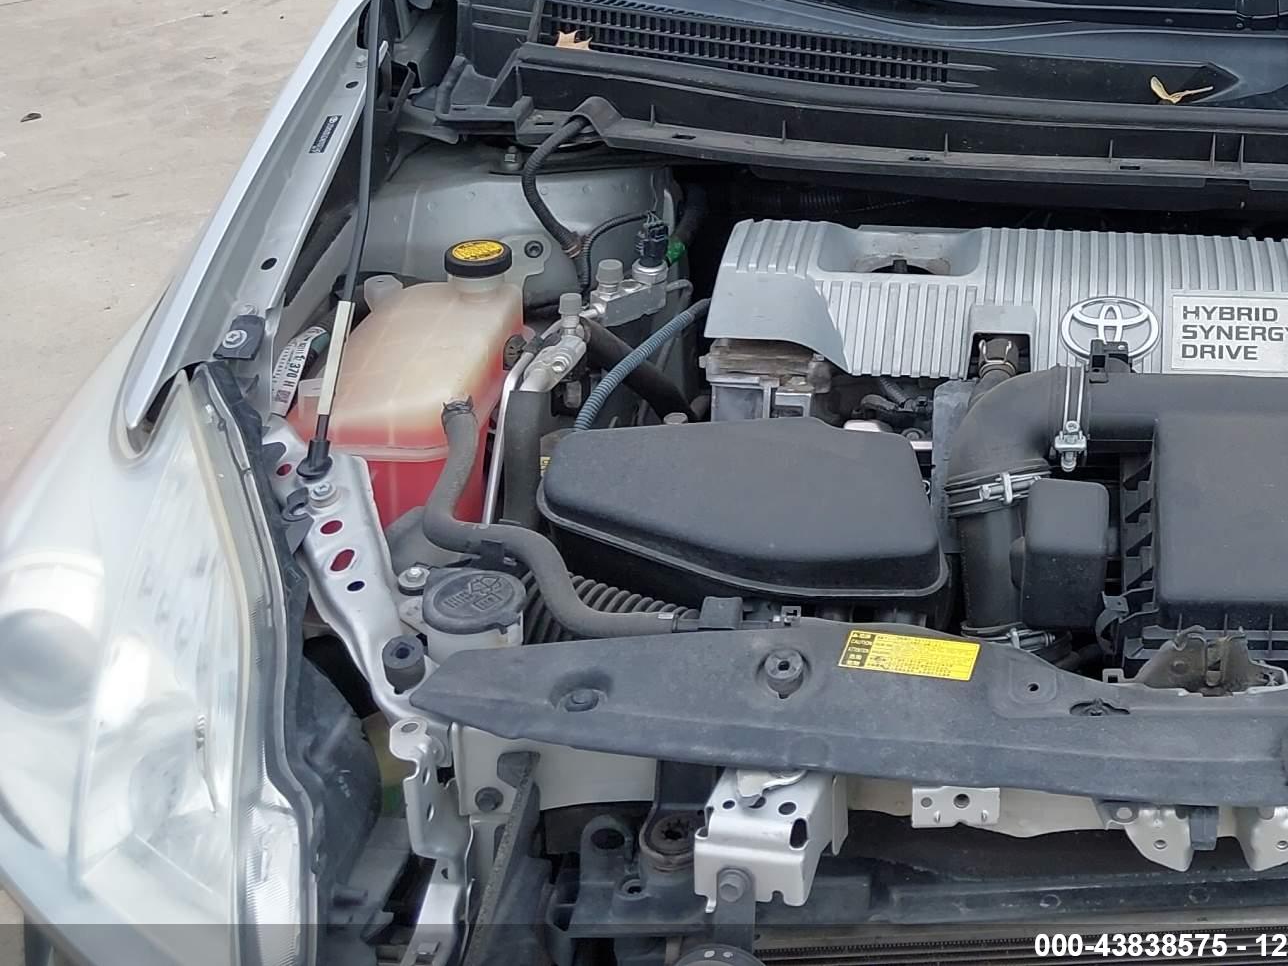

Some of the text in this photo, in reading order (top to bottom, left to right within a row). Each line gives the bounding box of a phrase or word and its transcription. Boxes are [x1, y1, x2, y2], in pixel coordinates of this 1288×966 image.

[1182, 305, 1278, 322] HYBRID
[1181, 344, 1258, 361] DRIVE
[851, 638, 872, 646] CAUTION
